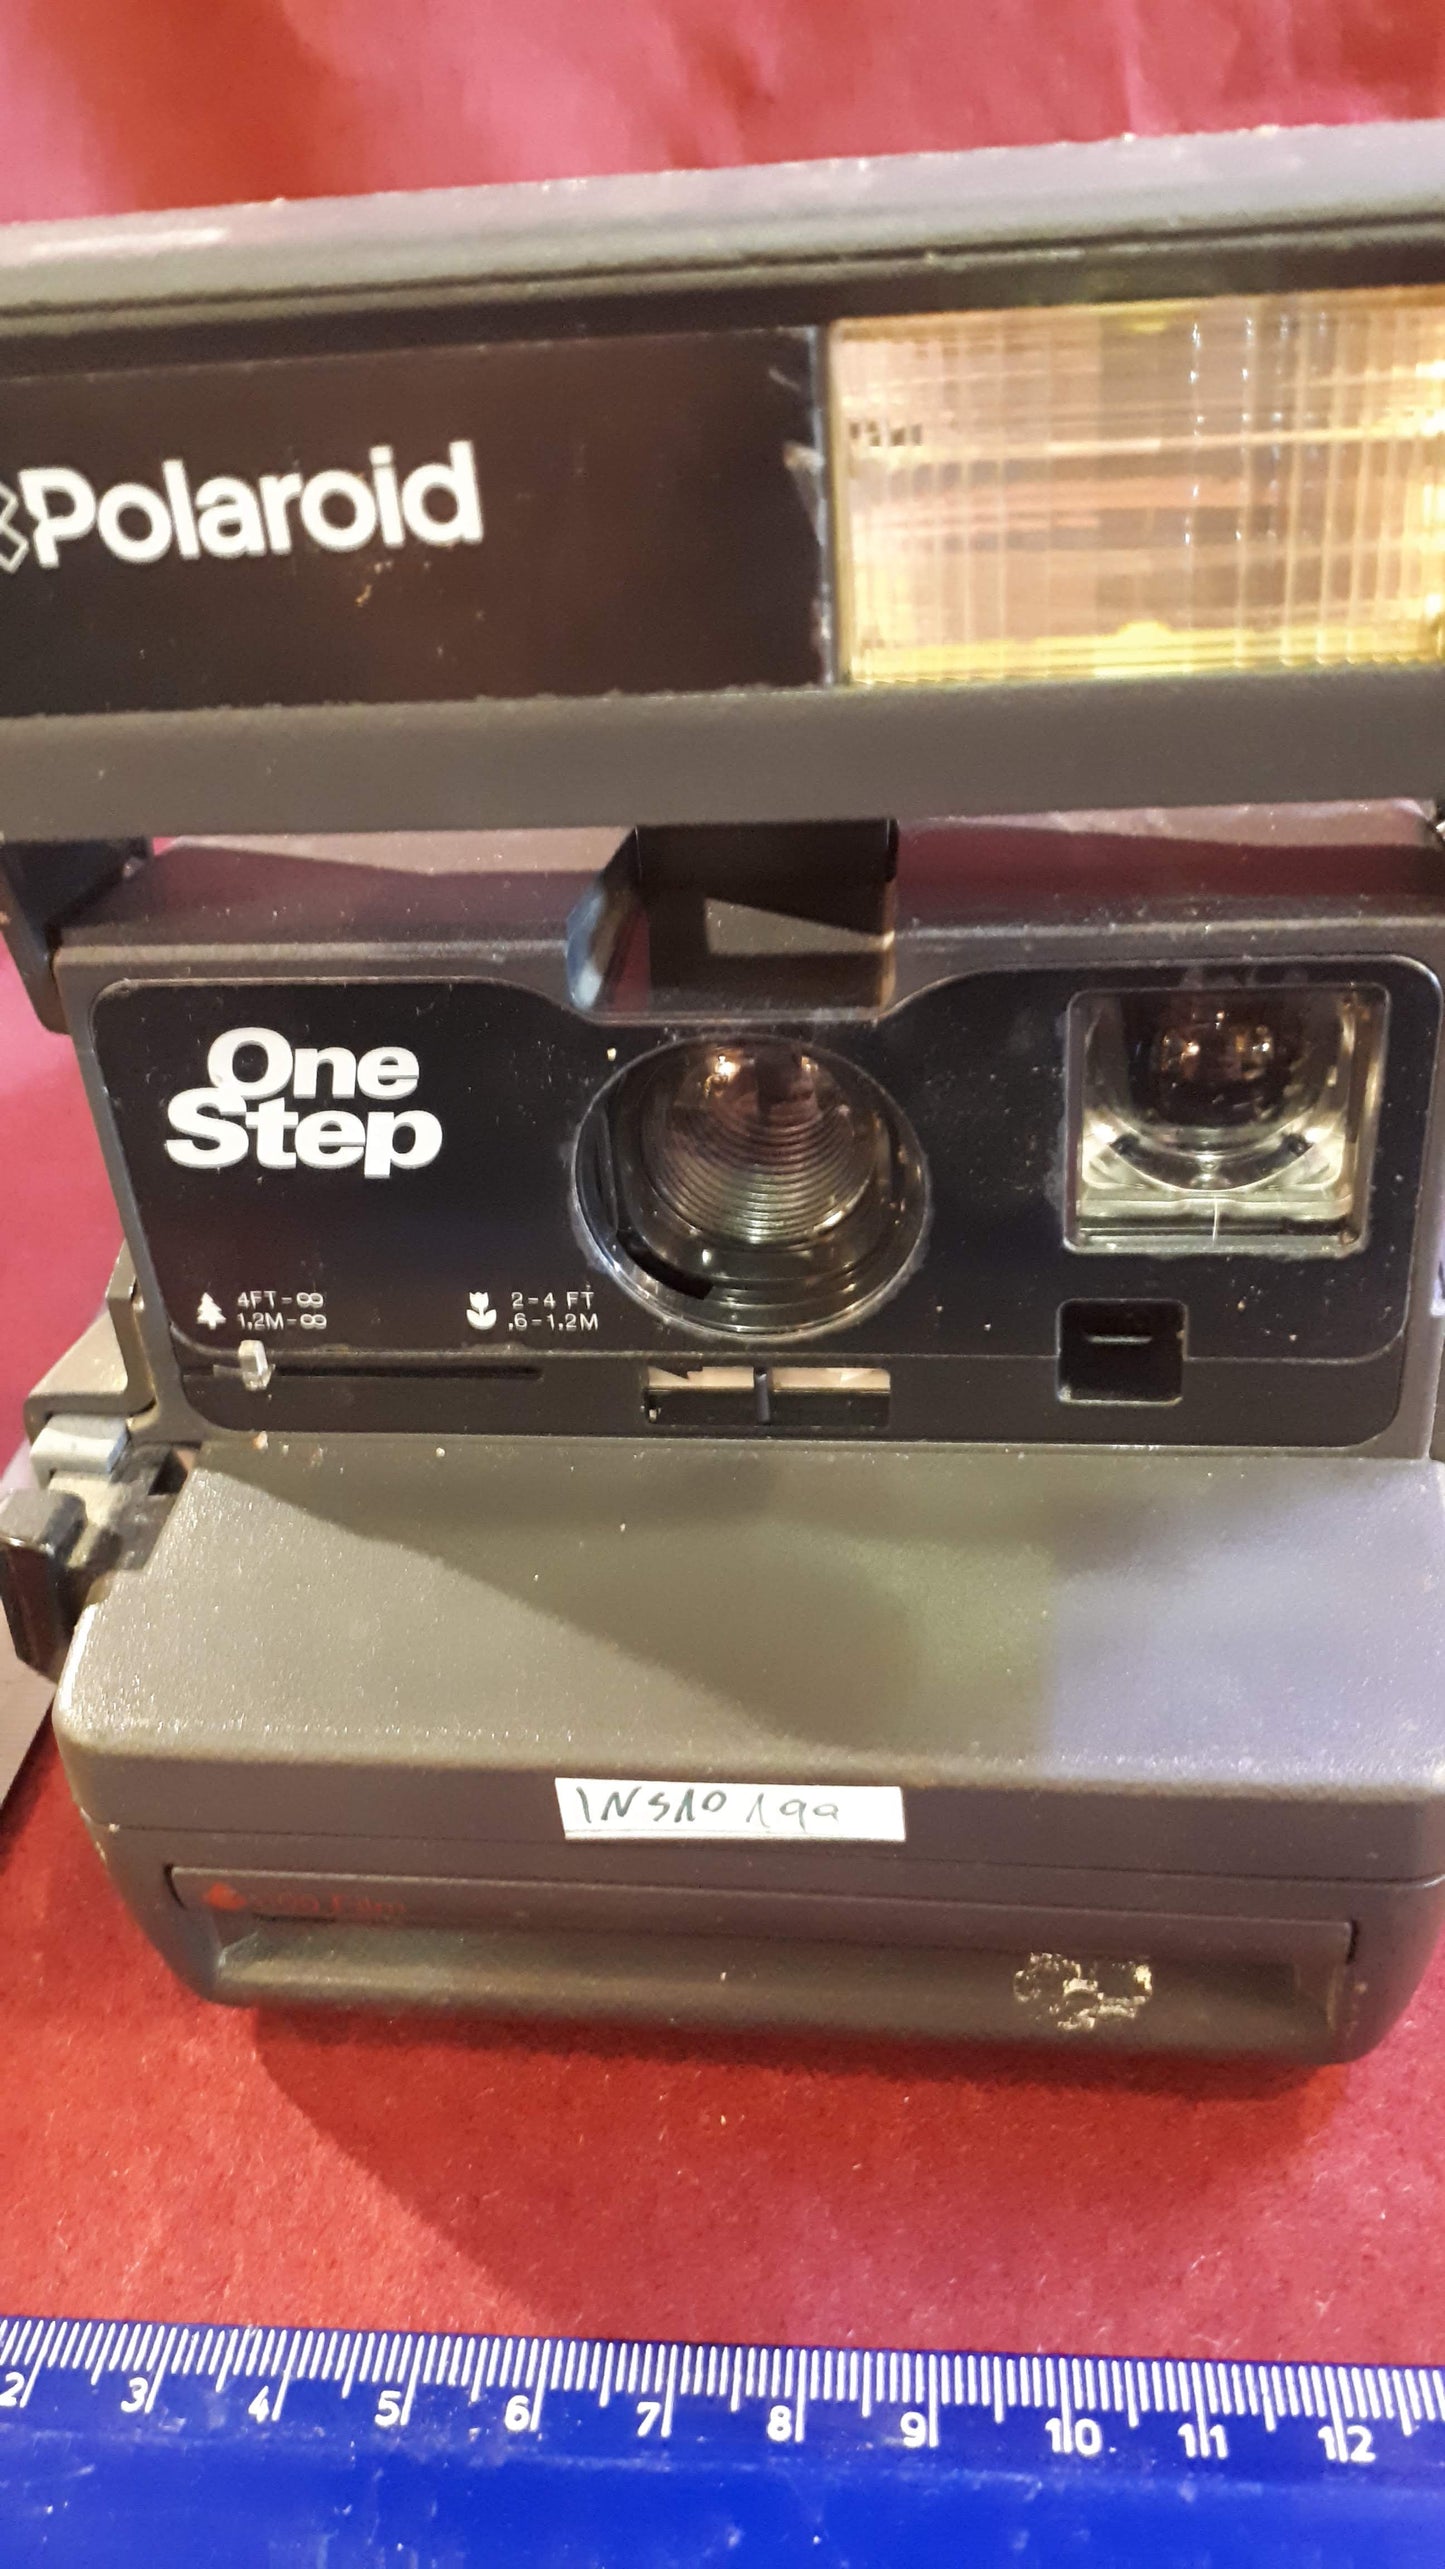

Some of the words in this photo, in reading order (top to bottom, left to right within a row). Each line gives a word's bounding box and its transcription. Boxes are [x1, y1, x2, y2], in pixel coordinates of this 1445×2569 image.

[18, 440, 484, 568] Polaroid
[207, 1026, 420, 1101] One
[165, 1086, 443, 1179] Step
[566, 1291, 594, 1310] FT
[0, 2371, 26, 2407] 2
[121, 2377, 149, 2413] 3
[248, 2385, 270, 2424] 4
[374, 2390, 402, 2427] 5
[504, 2394, 531, 2431] 6
[636, 2401, 662, 2437] 7
[767, 2404, 793, 2442] 8
[900, 2411, 927, 2448] 9
[1044, 2417, 1102, 2457] 10
[1317, 2425, 1377, 2463] 12
